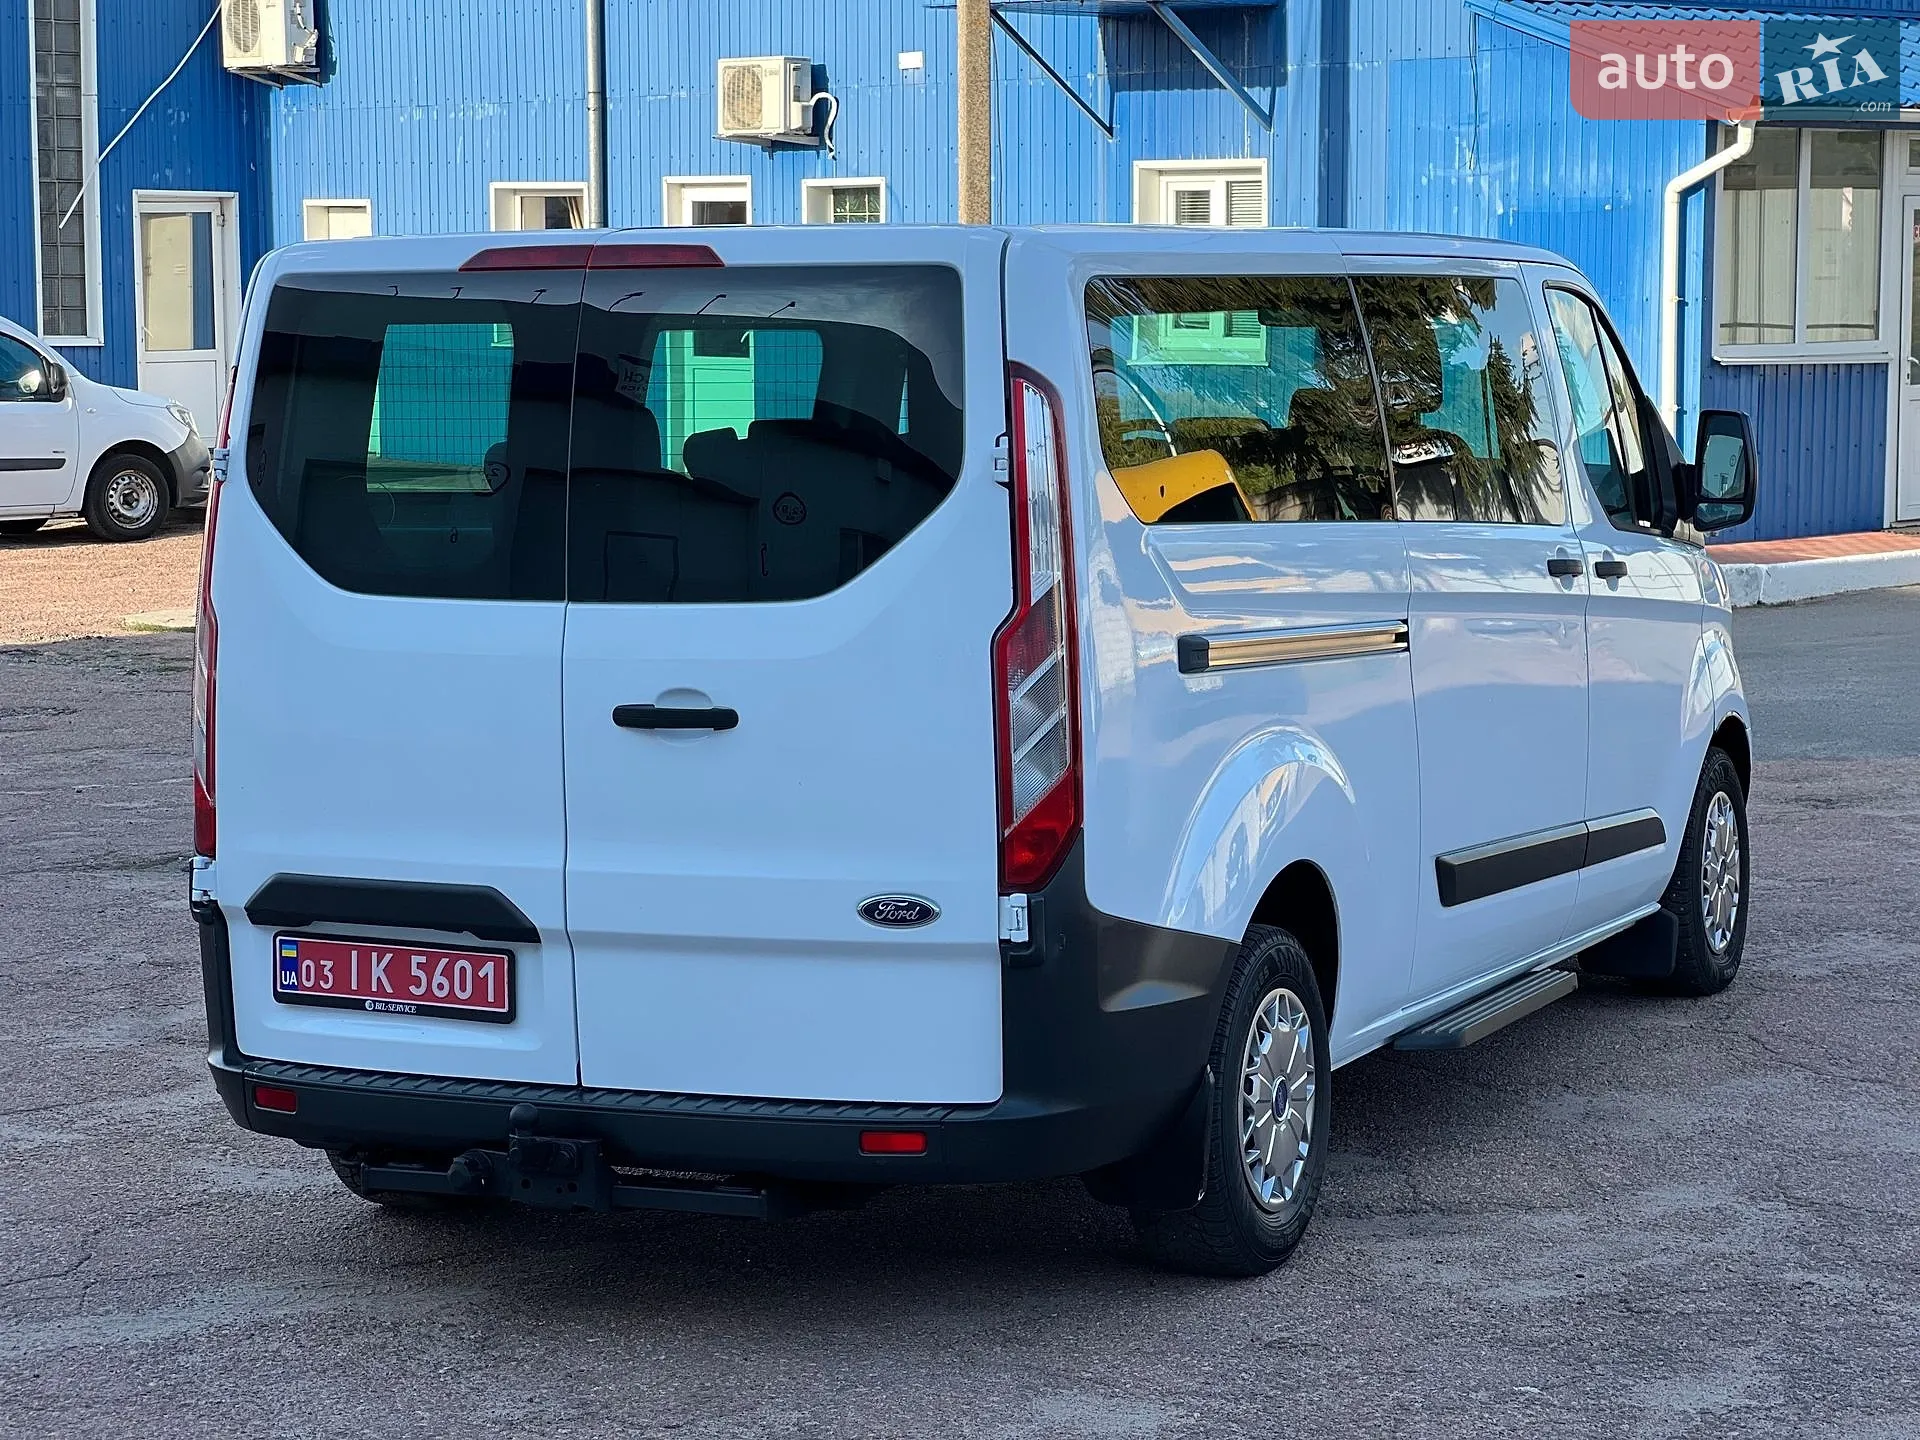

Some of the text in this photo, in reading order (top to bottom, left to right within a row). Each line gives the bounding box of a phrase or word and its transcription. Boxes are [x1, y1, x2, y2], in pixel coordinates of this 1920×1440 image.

[874, 901, 920, 920] Ford
[281, 970, 298, 986] UA
[301, 959, 334, 990] 03
[408, 955, 495, 1003] 5601
